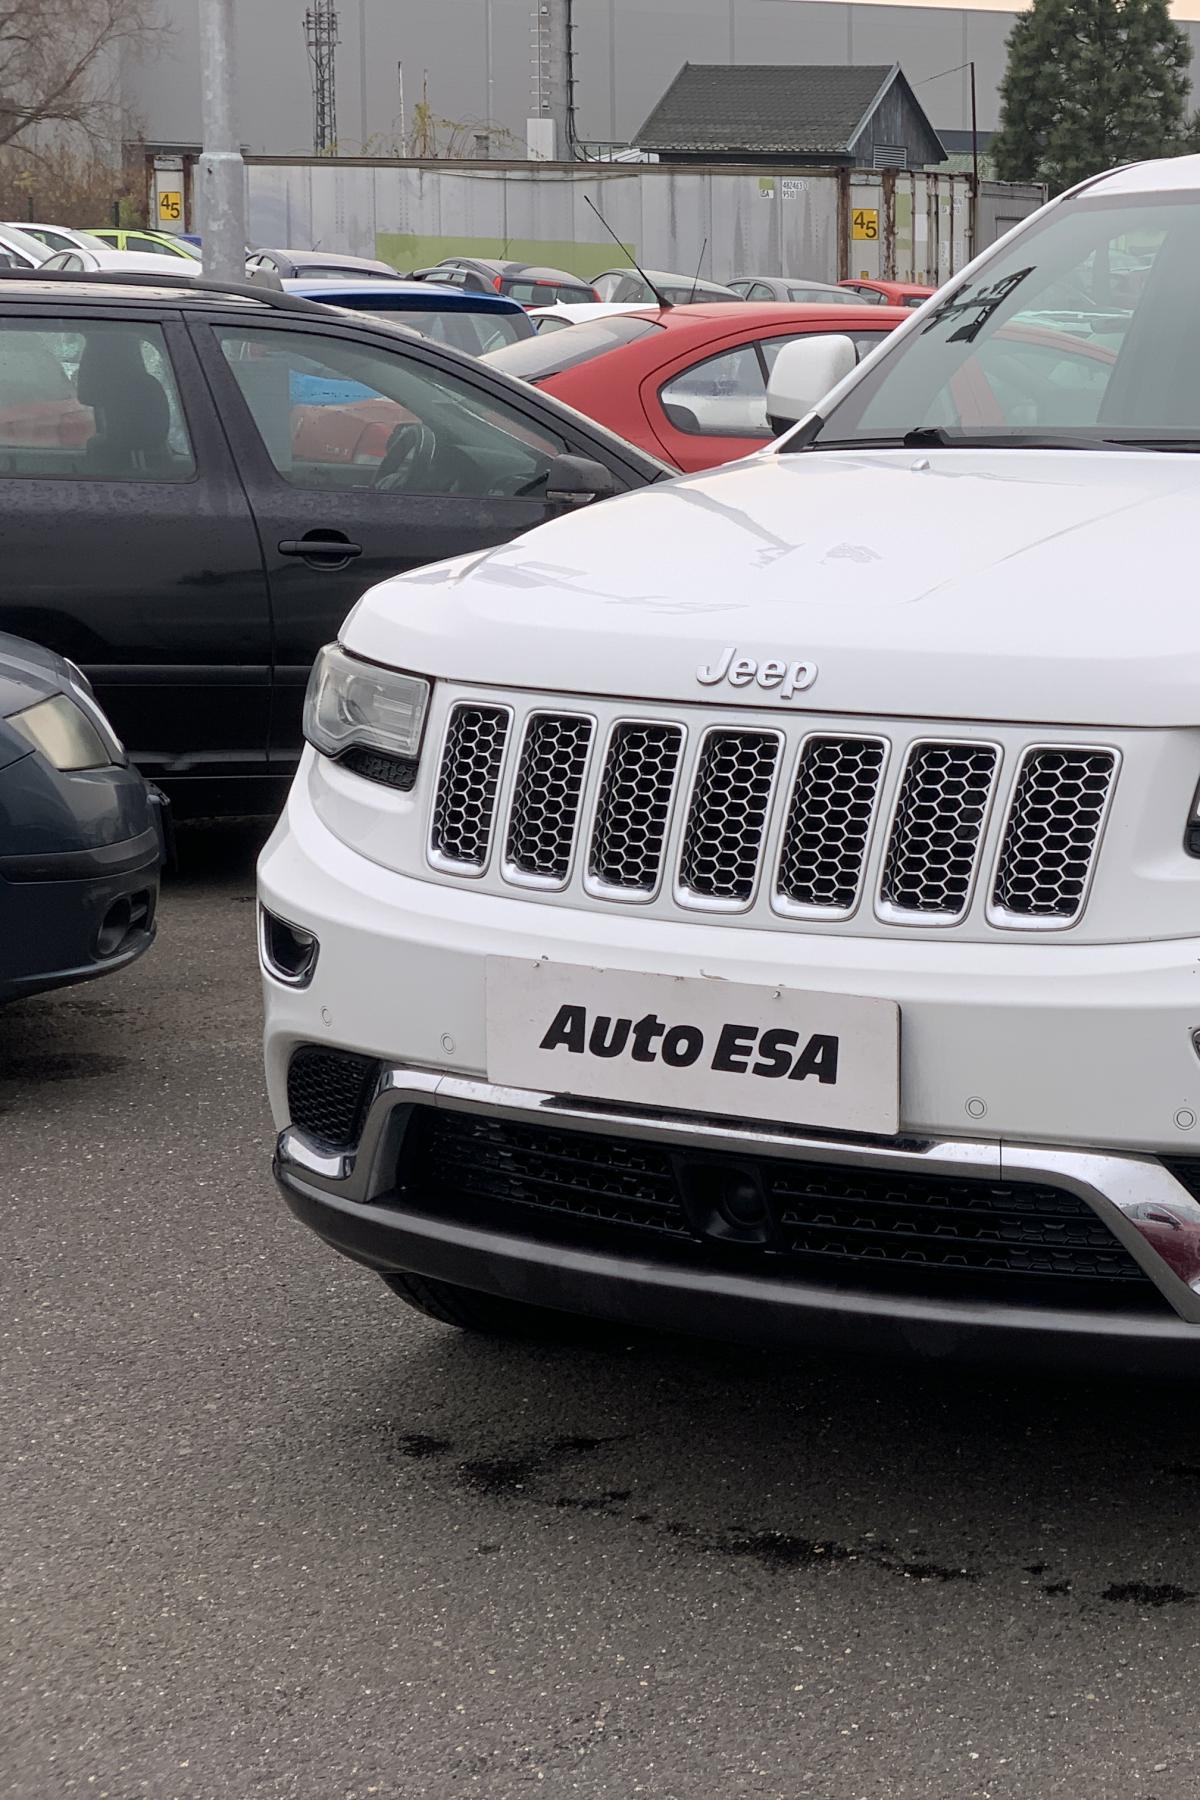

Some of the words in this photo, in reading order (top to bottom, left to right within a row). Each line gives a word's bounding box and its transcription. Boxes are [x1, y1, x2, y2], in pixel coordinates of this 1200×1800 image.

[161, 194, 180, 218] 45
[854, 211, 877, 238] 45
[696, 647, 819, 700] Jeep
[539, 1004, 704, 1068] Auto
[711, 1023, 839, 1085] ESA
